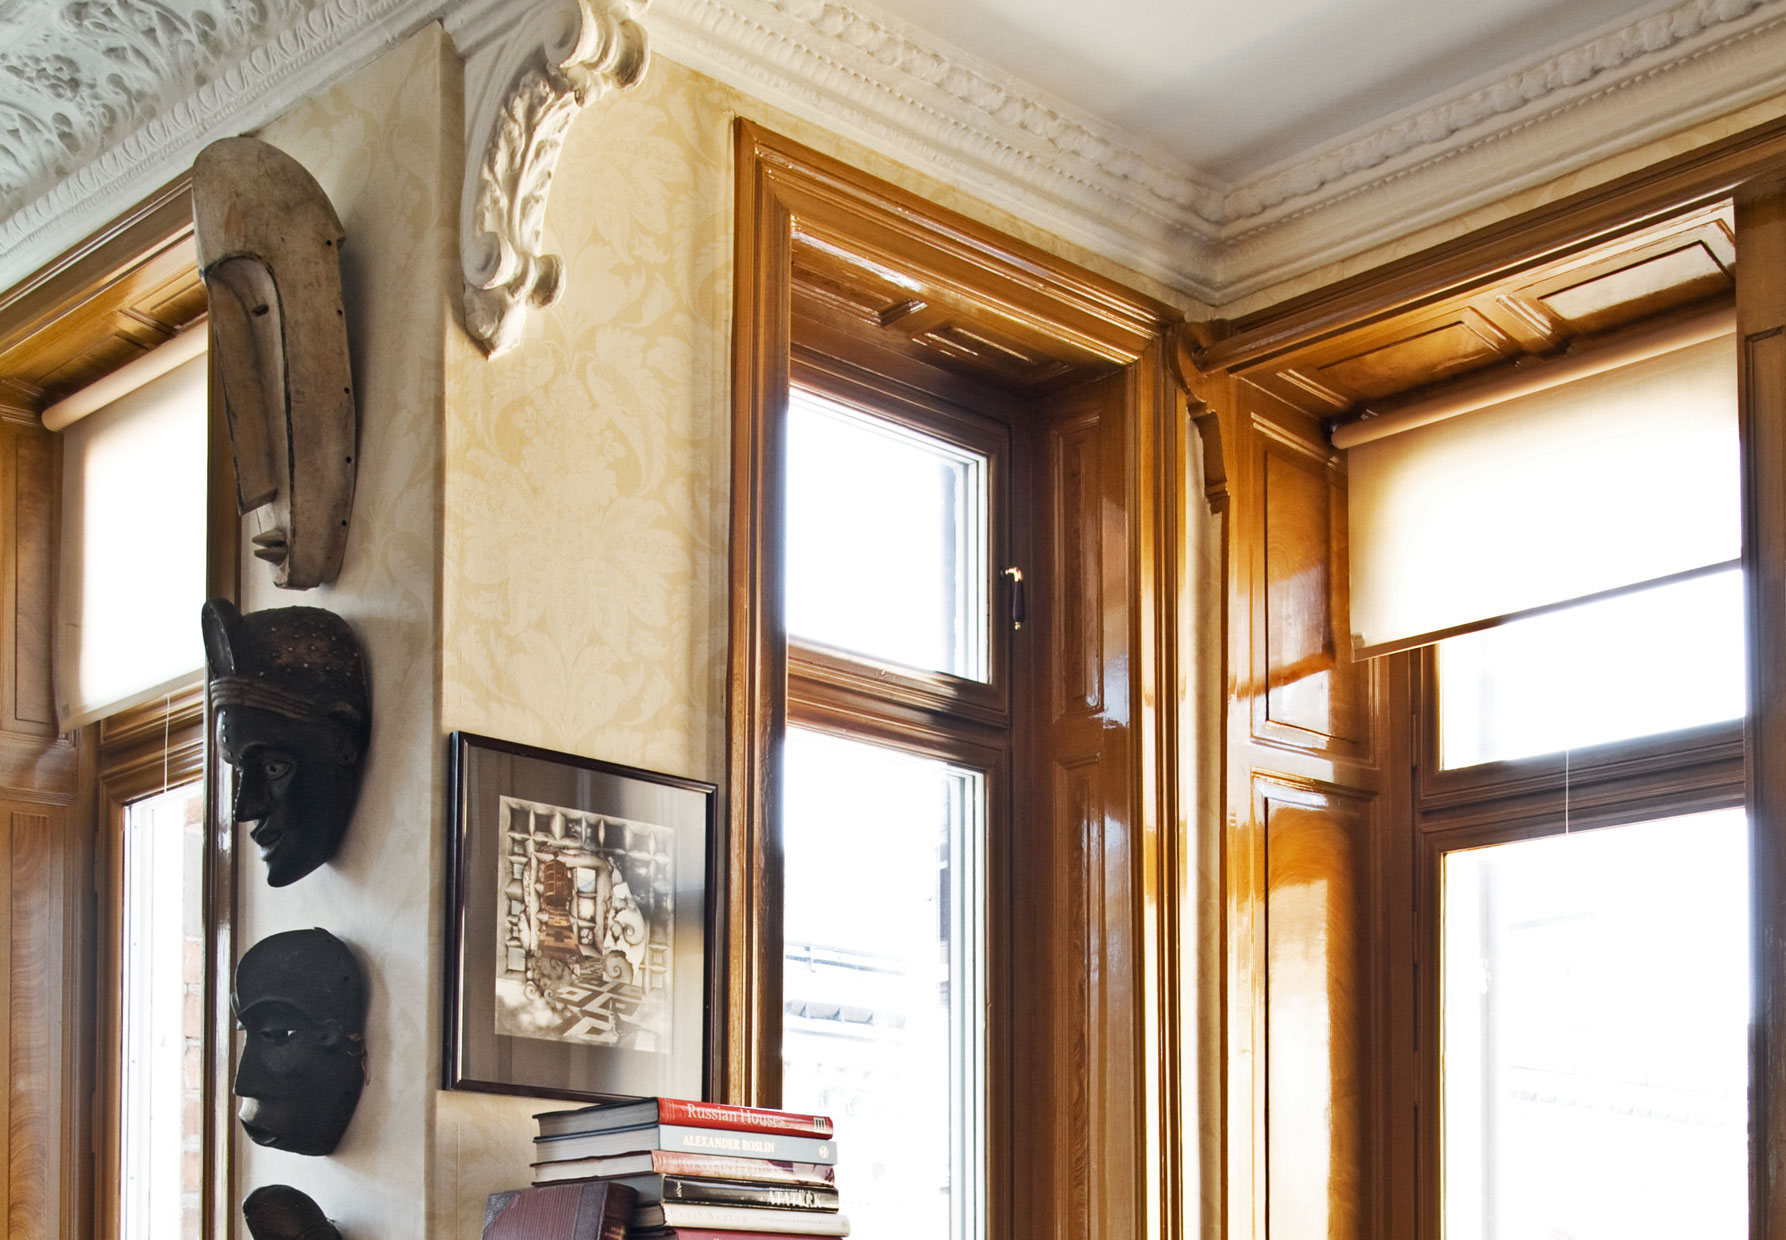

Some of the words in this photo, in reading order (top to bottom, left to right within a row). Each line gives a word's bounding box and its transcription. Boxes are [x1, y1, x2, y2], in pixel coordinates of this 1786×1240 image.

[687, 1103, 737, 1123] Russian
[740, 1110, 785, 1128] Houses
[683, 1135, 740, 1151] ALEXANDER
[742, 1139, 775, 1153] ROSLIN
